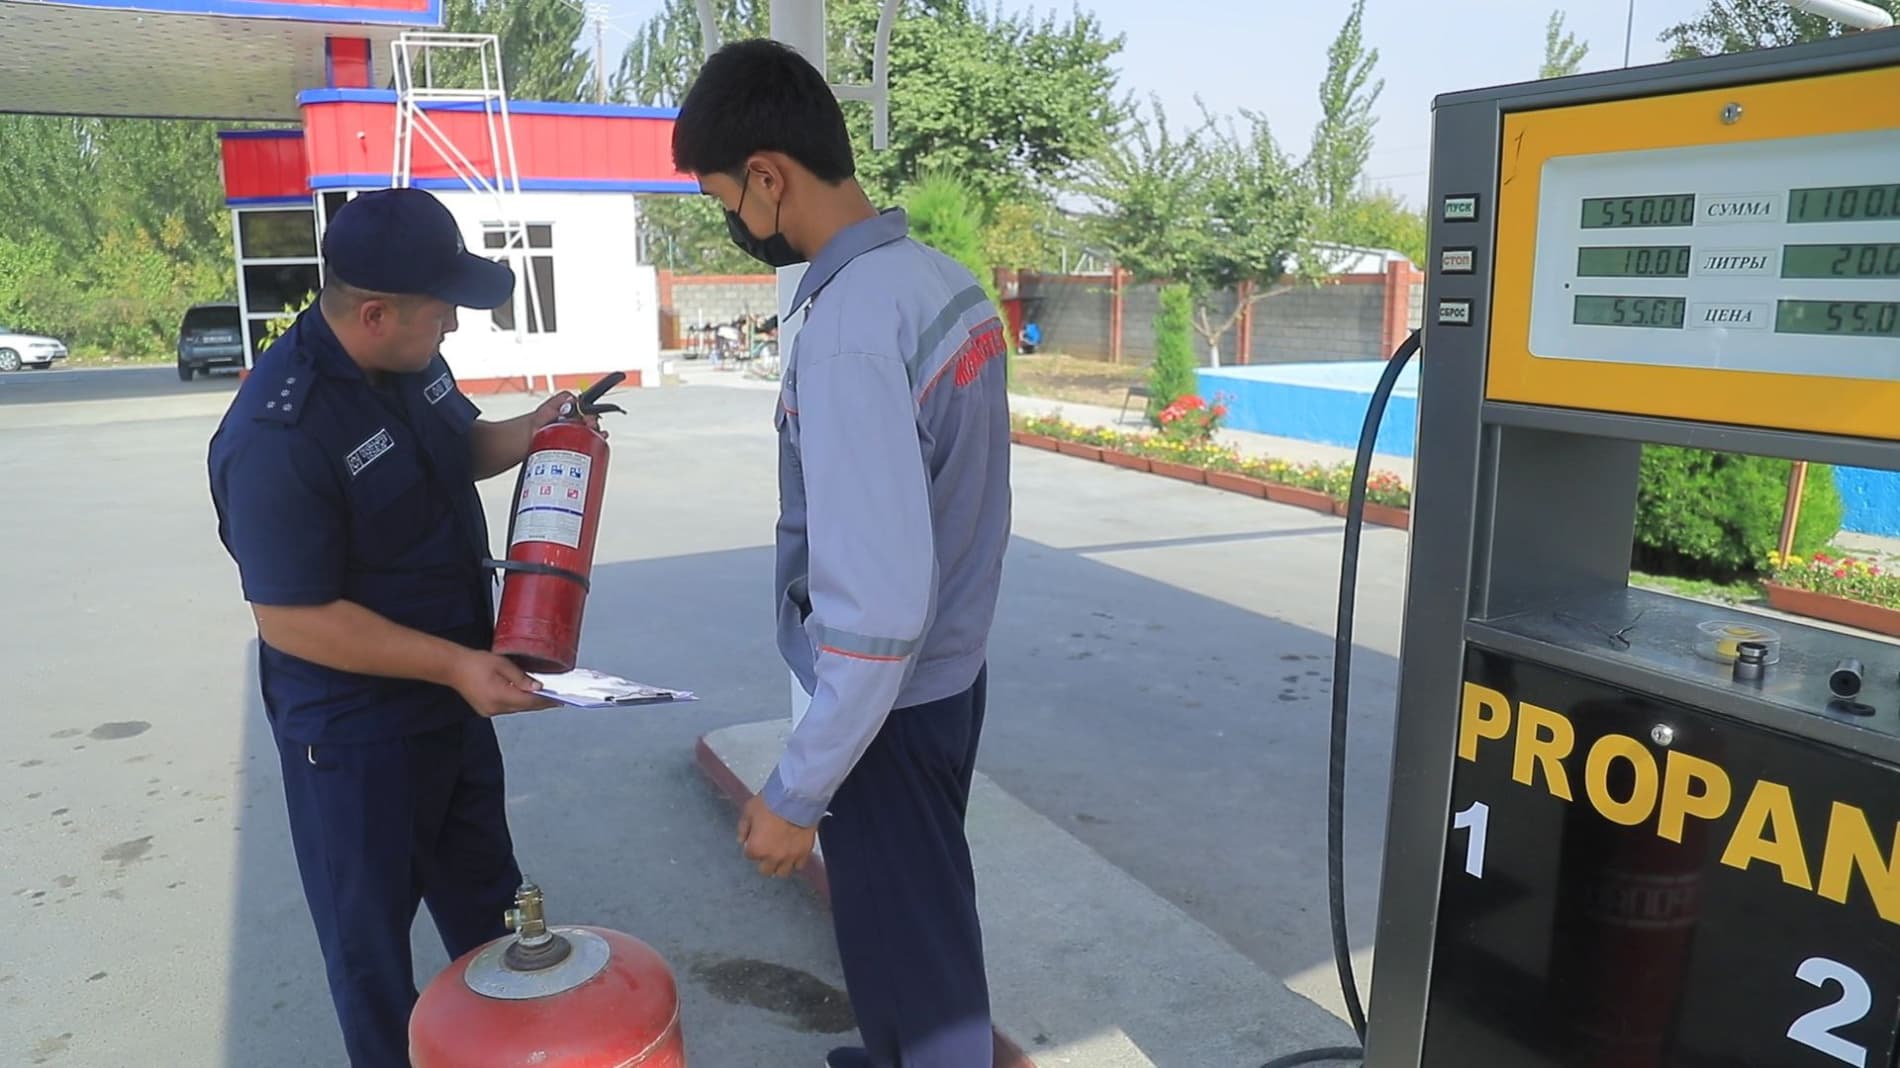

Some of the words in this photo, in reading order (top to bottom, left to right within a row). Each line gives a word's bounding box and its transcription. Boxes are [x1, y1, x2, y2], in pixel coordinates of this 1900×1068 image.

[1446, 202, 1473, 213] ПУСК
[1707, 203, 1771, 217] СУММА
[1442, 255, 1471, 265] СТОП
[1703, 256, 1768, 270] ЛИТРЫ
[1440, 308, 1465, 317] СБРОС
[1705, 308, 1752, 324] ЦЕНА
[1457, 681, 1900, 926] PROPAN
[1453, 801, 1489, 879] 1
[1786, 956, 1872, 1068] 2
